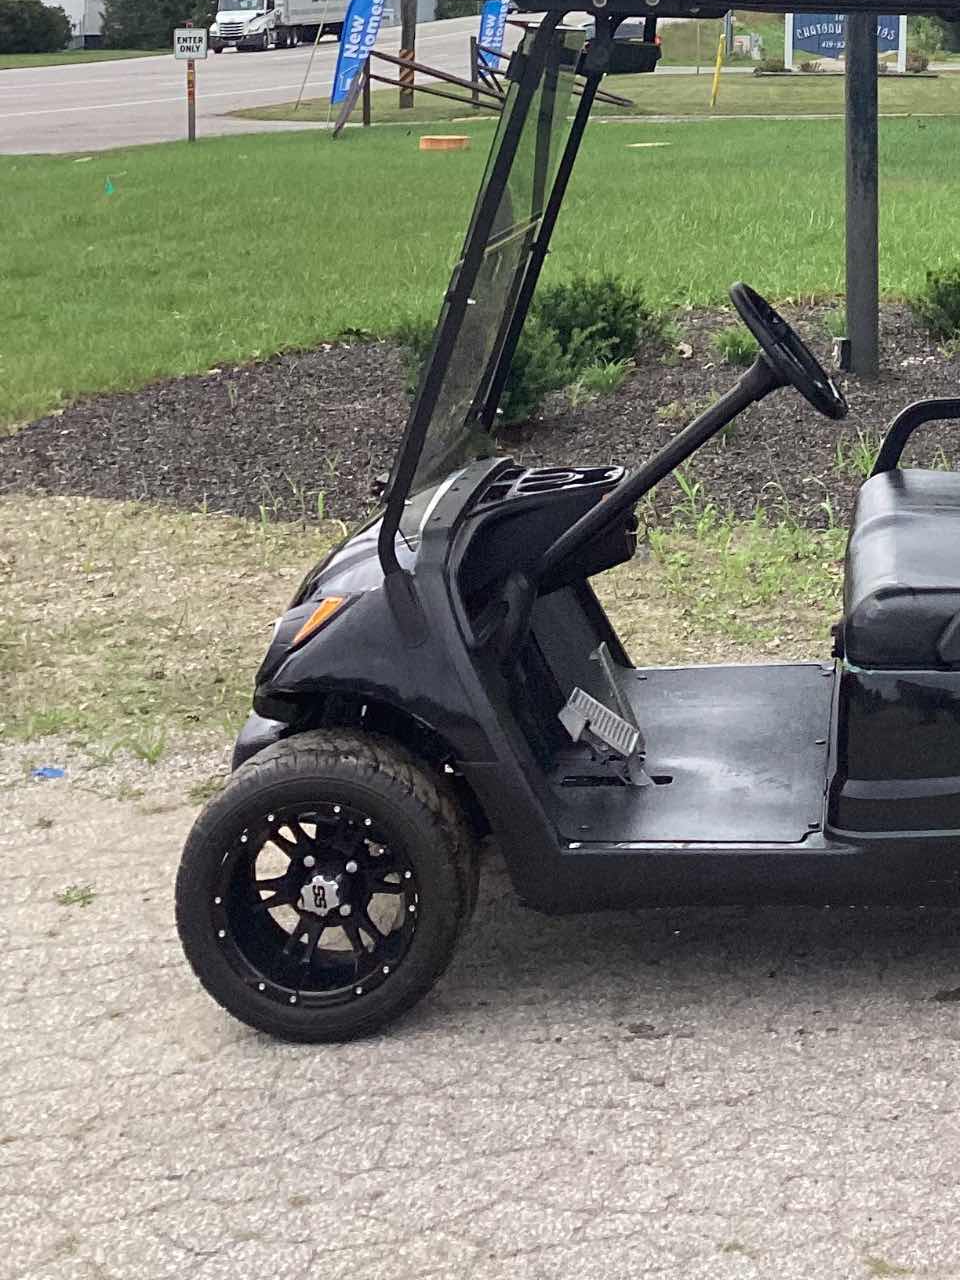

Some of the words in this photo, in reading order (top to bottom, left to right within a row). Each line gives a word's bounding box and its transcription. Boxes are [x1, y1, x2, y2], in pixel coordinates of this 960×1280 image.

[176, 36, 203, 45] ENTER
[343, 15, 364, 58] New
[180, 44, 201, 53] ONLY
